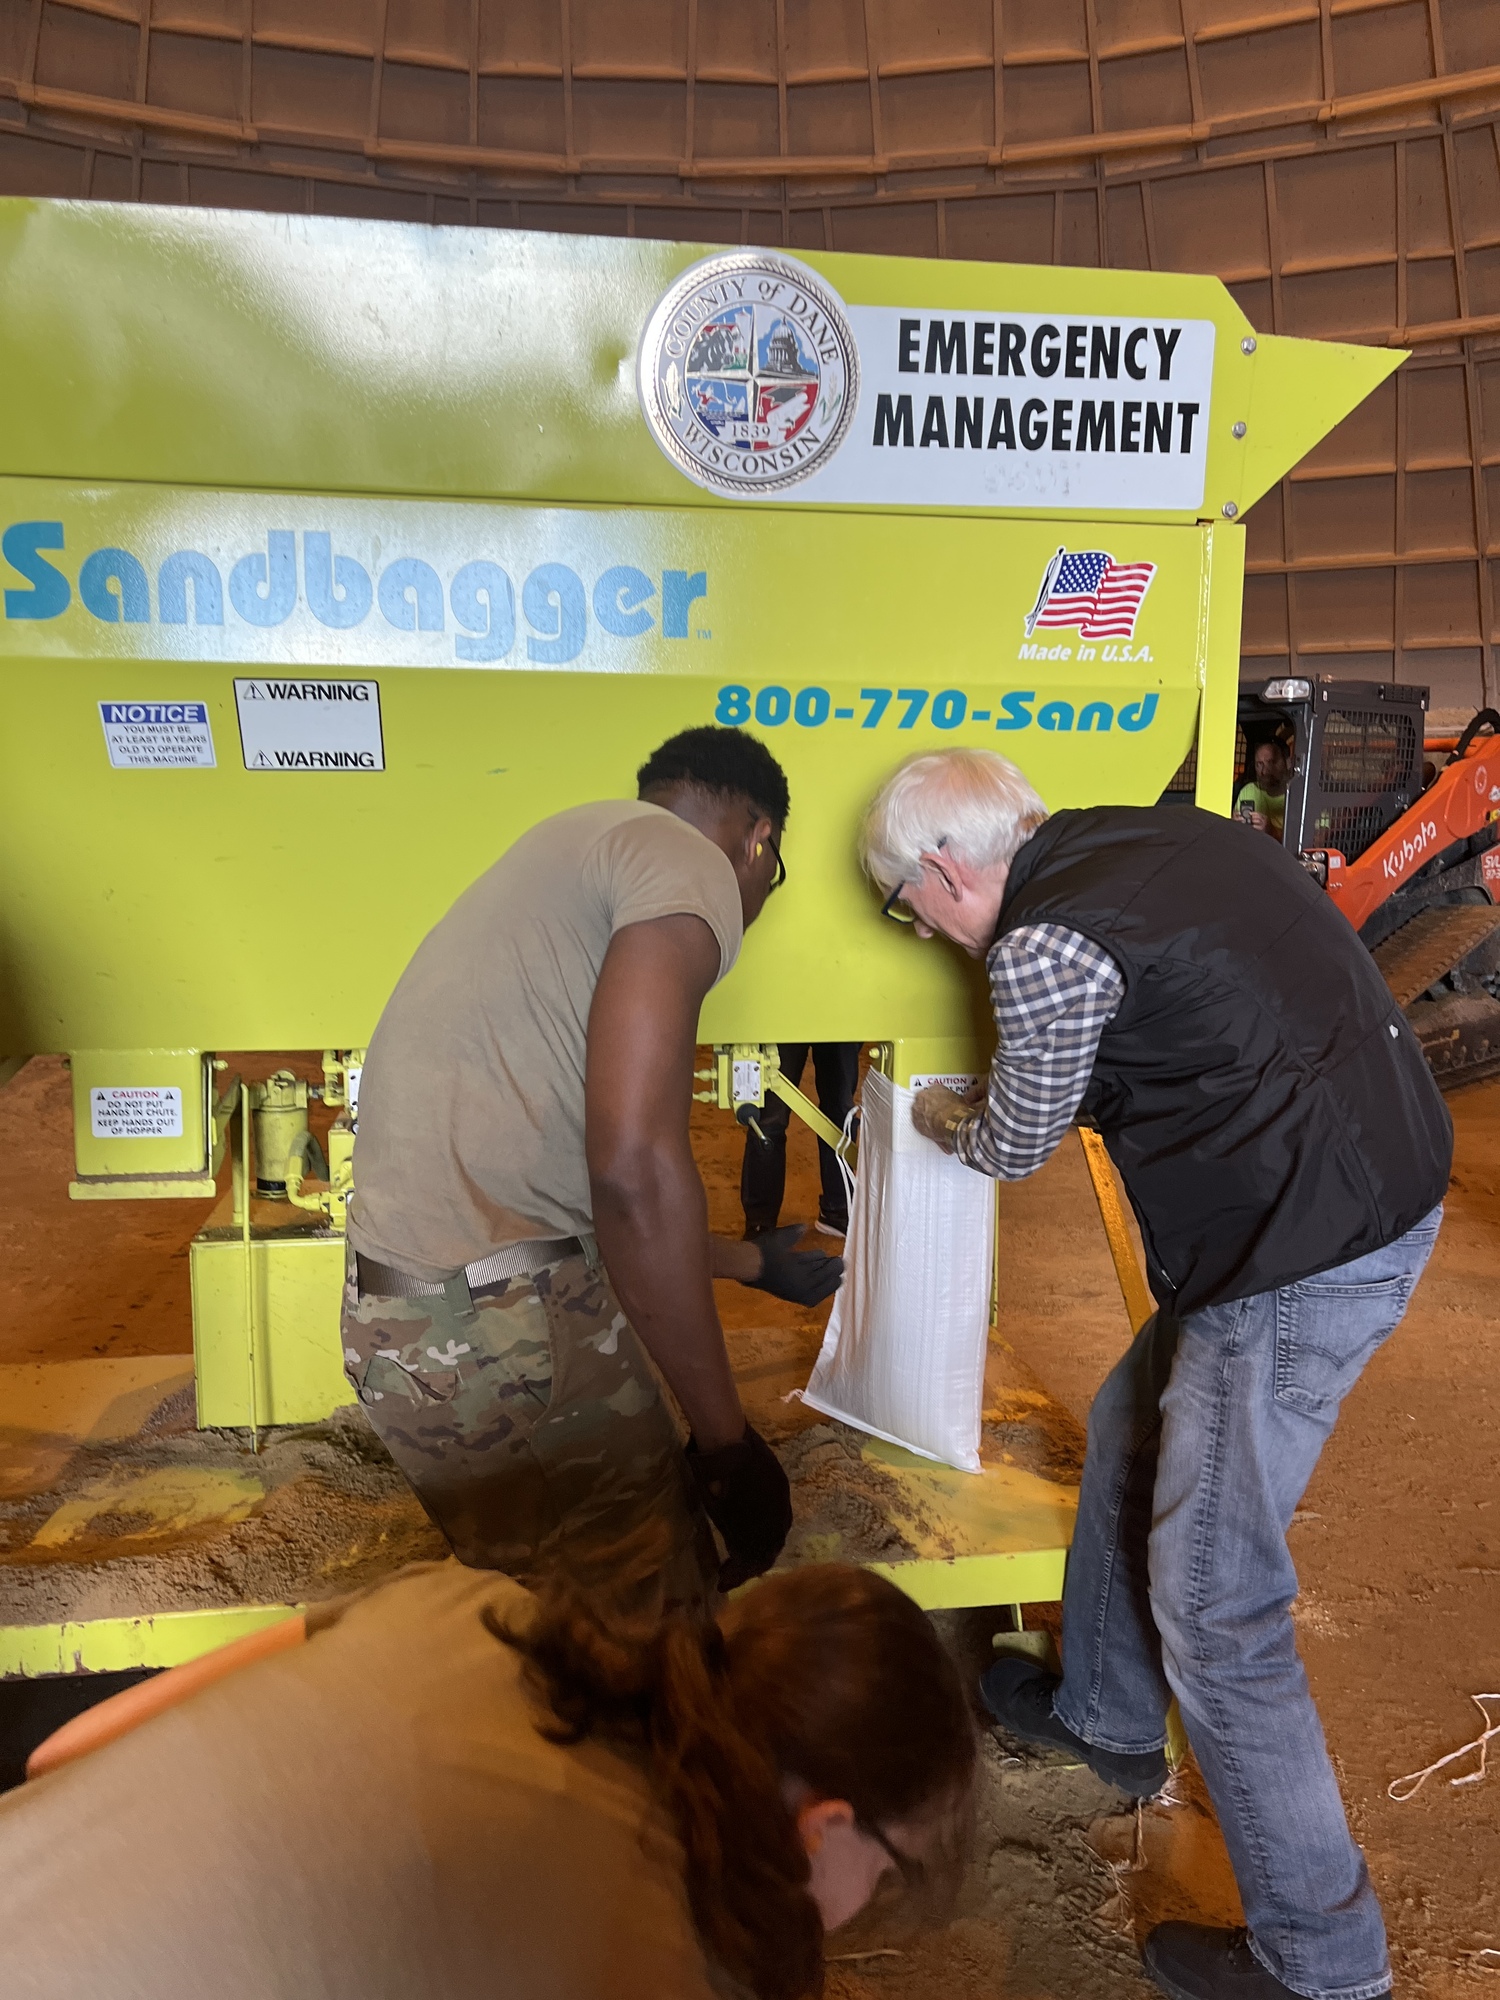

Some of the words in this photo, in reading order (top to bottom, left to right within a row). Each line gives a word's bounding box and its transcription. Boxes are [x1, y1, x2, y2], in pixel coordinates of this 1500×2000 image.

[665, 277, 747, 358] COUNTY
[758, 280, 785, 300] of
[787, 293, 840, 366] DANE
[898, 318, 1181, 380] EMERGENCY
[732, 423, 771, 438] 1839
[872, 395, 1200, 453] MANAGEMENT
[682, 420, 821, 475] WISCONSIN
[2, 521, 707, 664] Sandbagger
[1018, 644, 1071, 660] Made
[1076, 645, 1096, 661] in
[1101, 645, 1154, 662] U.S.A.
[266, 684, 369, 701] WARNING
[111, 705, 198, 722] NOTICE
[714, 684, 1160, 732] 800-770-Sand
[123, 725, 145, 733] YOU
[147, 725, 175, 733] MUST
[177, 725, 191, 733] BE
[112, 735, 123, 743] AT
[127, 735, 158, 743] LEAST
[161, 735, 172, 743] 18
[174, 735, 207, 743] YEARS
[275, 752, 374, 768] WARNING
[1382, 820, 1437, 879] Kubota
[928, 1077, 967, 1085] CAUTION
[112, 1091, 159, 1099] CAUTION
